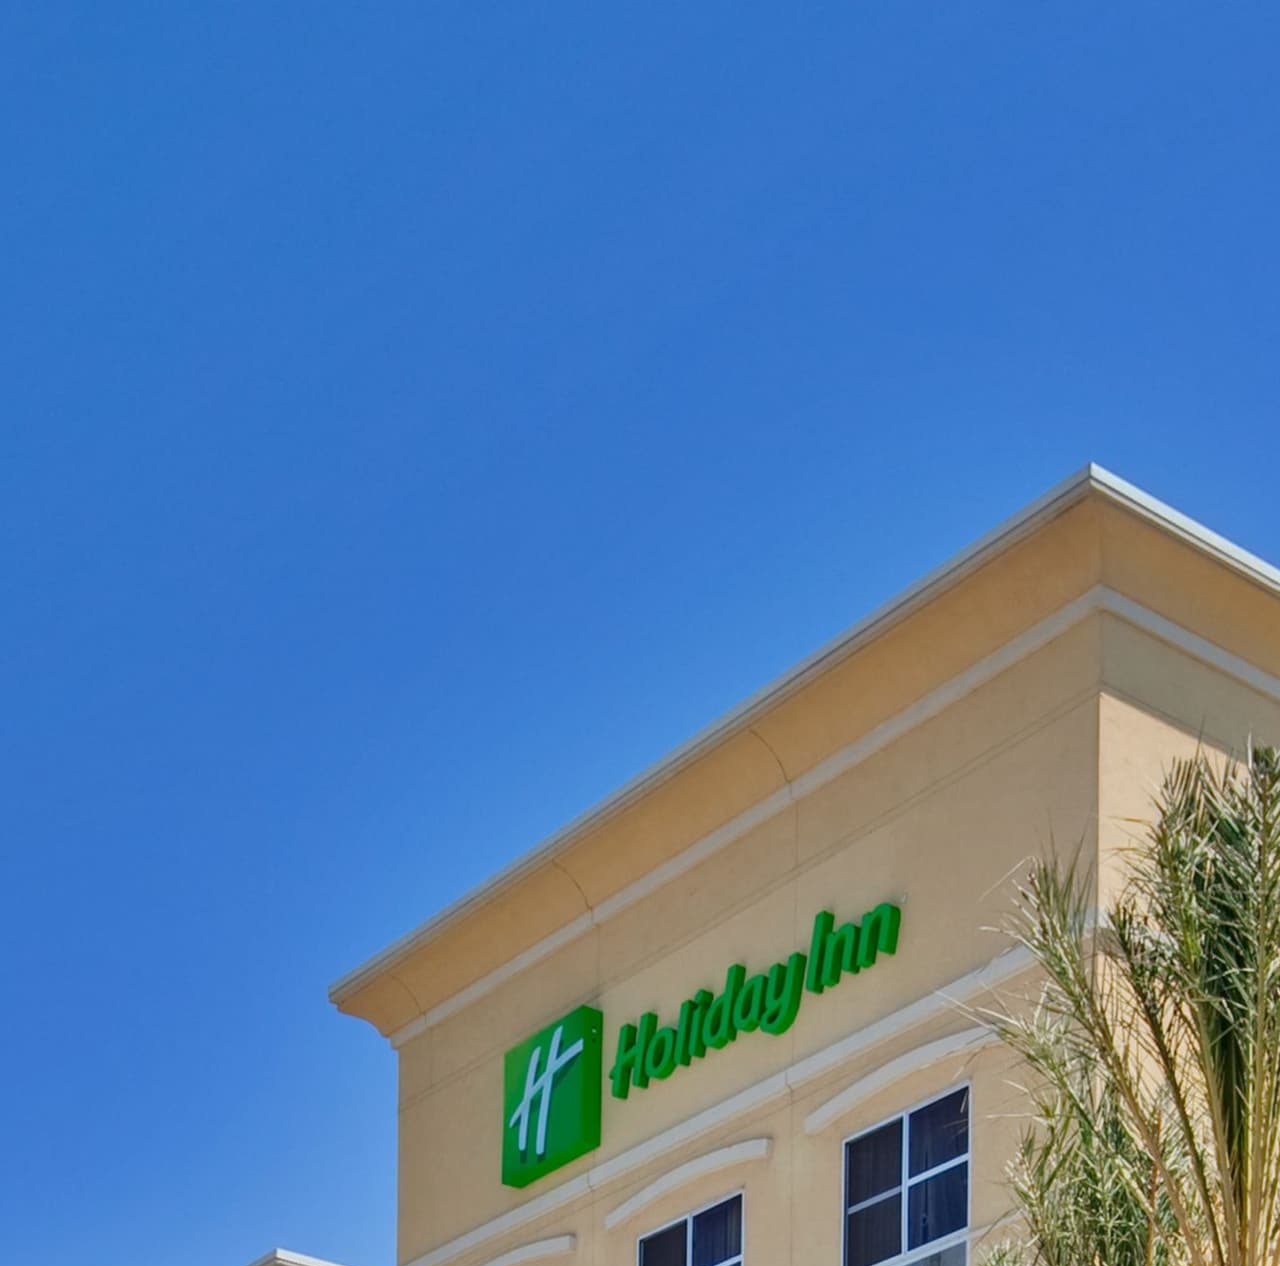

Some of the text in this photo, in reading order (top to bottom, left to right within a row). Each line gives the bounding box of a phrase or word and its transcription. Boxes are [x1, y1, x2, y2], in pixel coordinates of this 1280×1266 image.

[610, 902, 902, 1100] Holiday Inn
[509, 1025, 584, 1155] H
